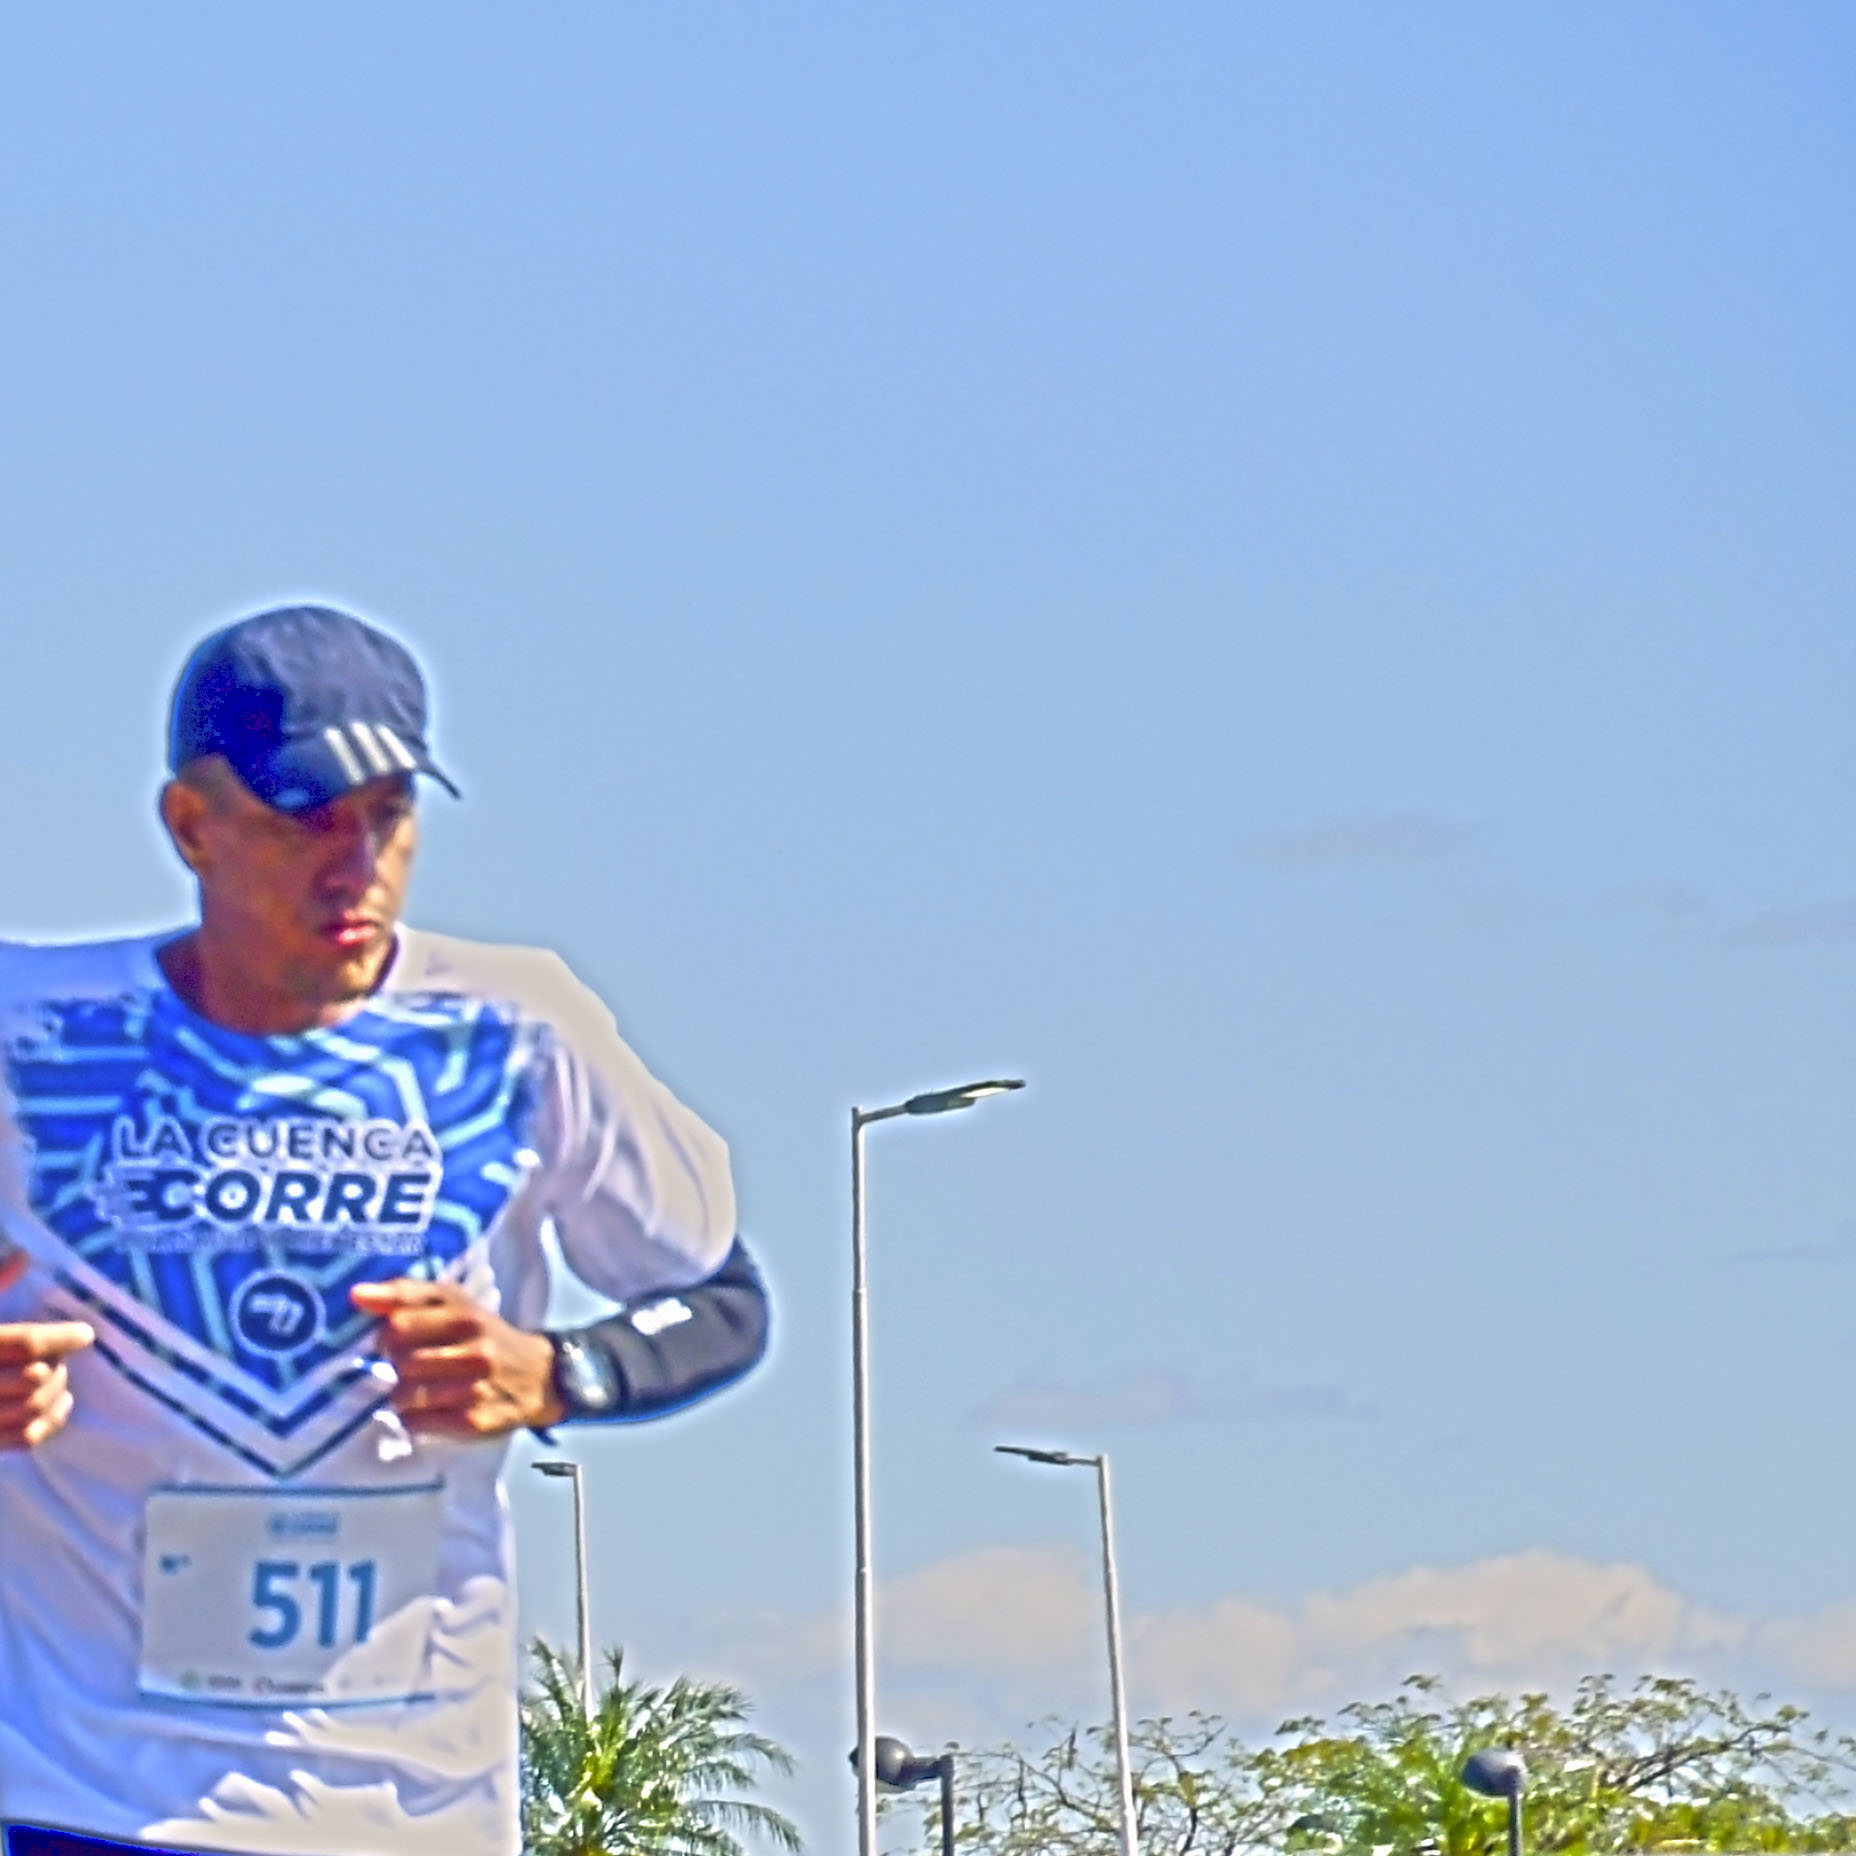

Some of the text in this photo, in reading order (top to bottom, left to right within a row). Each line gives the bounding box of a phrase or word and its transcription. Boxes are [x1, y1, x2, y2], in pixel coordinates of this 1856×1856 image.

[120, 1123, 434, 1160] LA CUENCA
[126, 1169, 432, 1224] CORRE
[248, 1560, 375, 1649] 511
